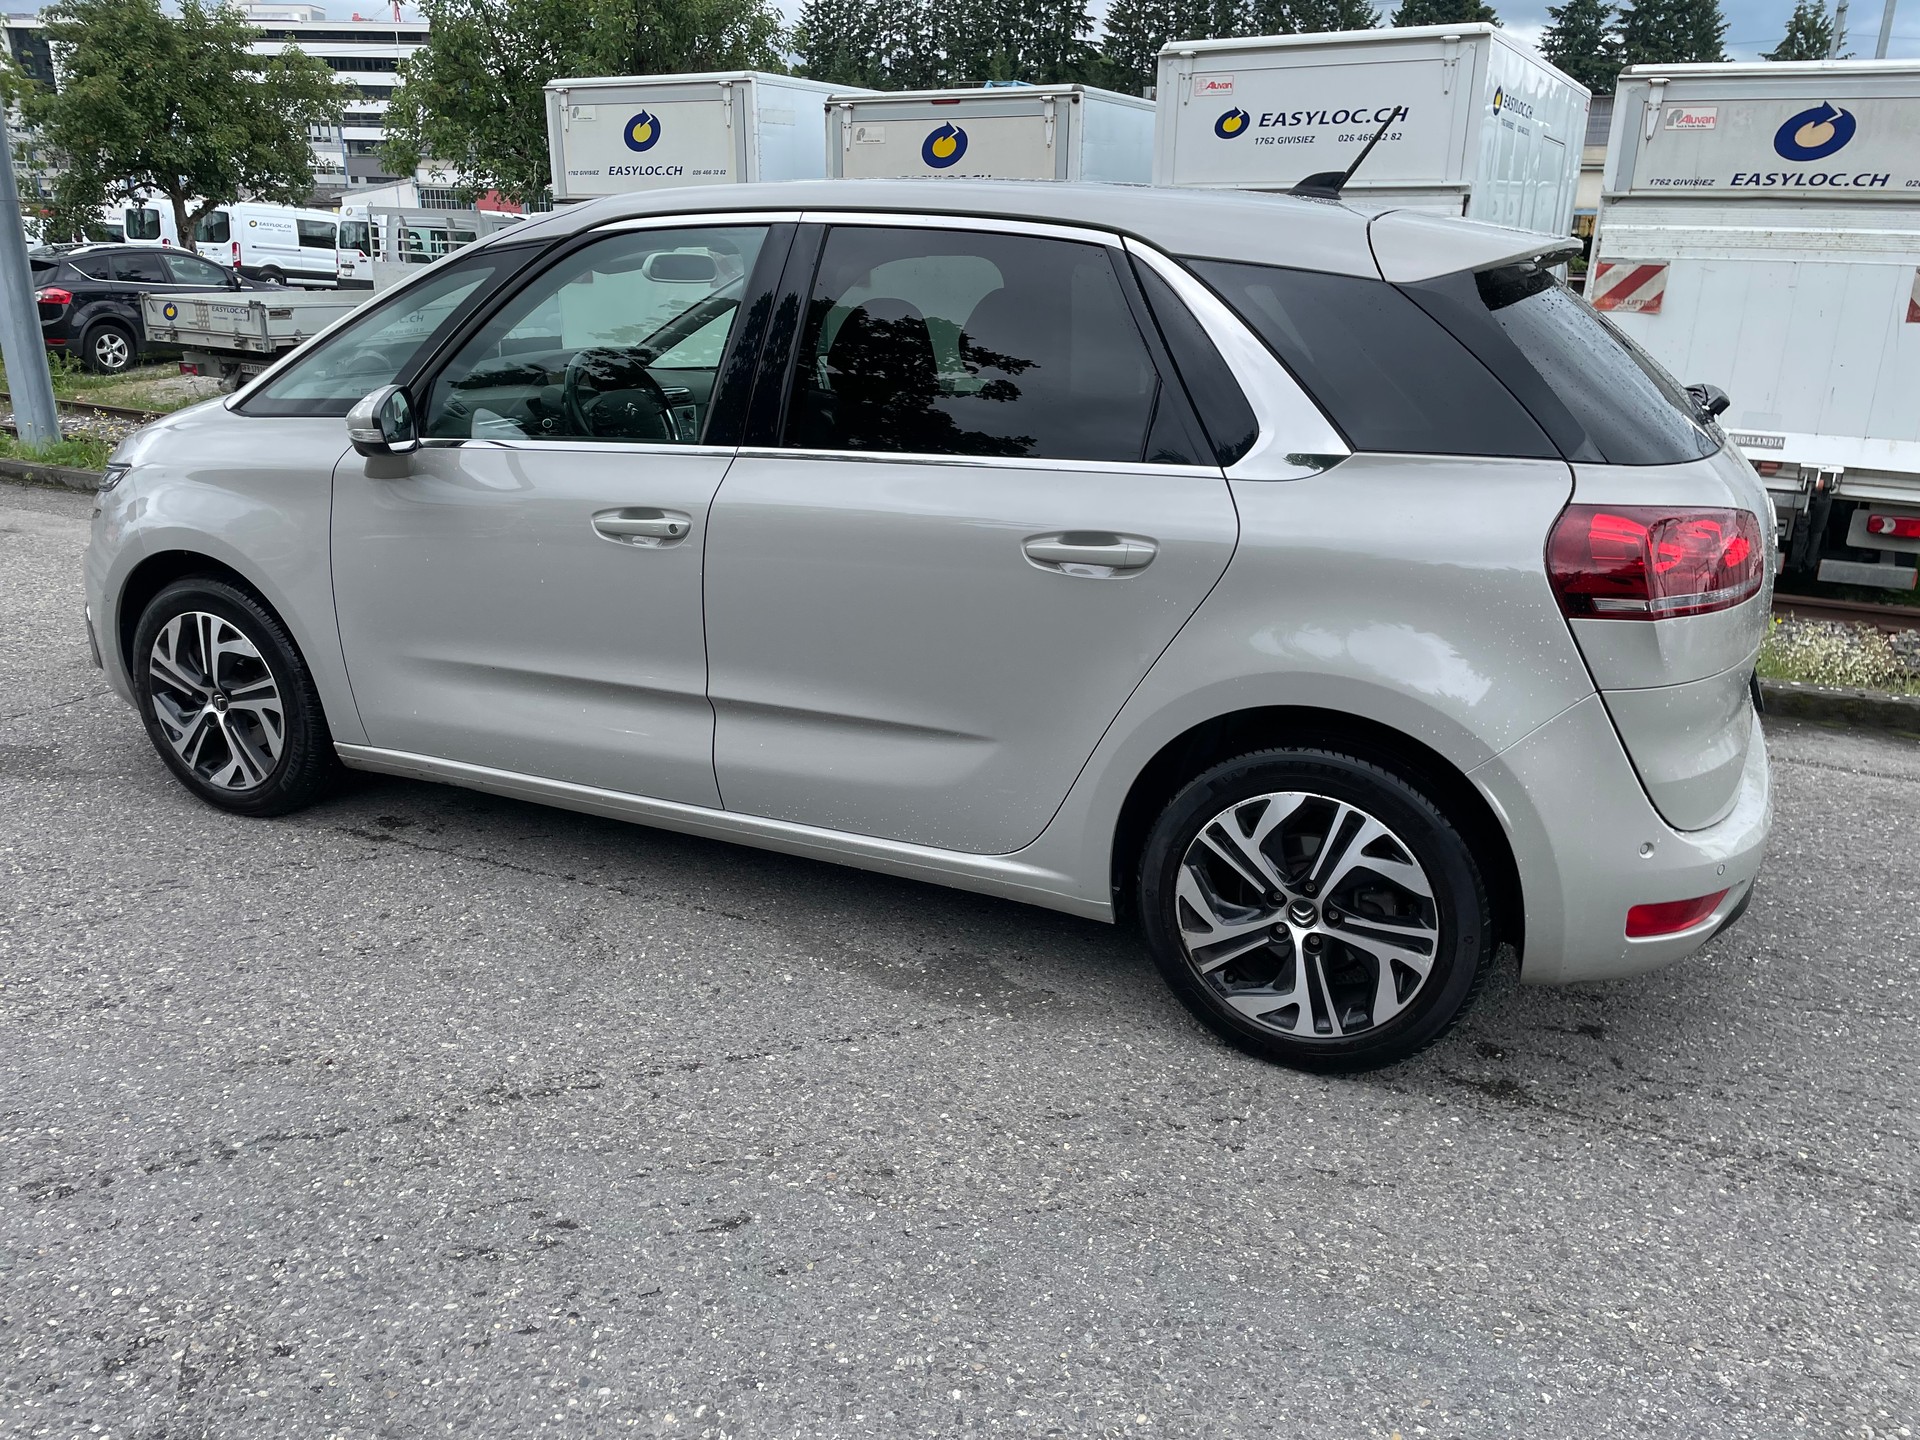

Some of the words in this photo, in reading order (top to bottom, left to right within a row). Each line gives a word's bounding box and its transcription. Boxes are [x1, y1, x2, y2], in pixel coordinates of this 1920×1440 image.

[1258, 106, 1410, 128] EASYLOC.CH
[1677, 114, 1715, 124] Aluvan
[1254, 137, 1275, 145] 1762
[1277, 136, 1315, 145] GIVISIEZ
[1338, 134, 1355, 142] 026
[1375, 132, 1388, 141] 2
[1390, 132, 1403, 141] 82
[608, 166, 683, 176] EASYLOC.CH
[1673, 179, 1716, 187] GIVISIEZ
[1730, 173, 1891, 187] EASYLOC.CH
[259, 221, 292, 229] EASYLOC.CH
